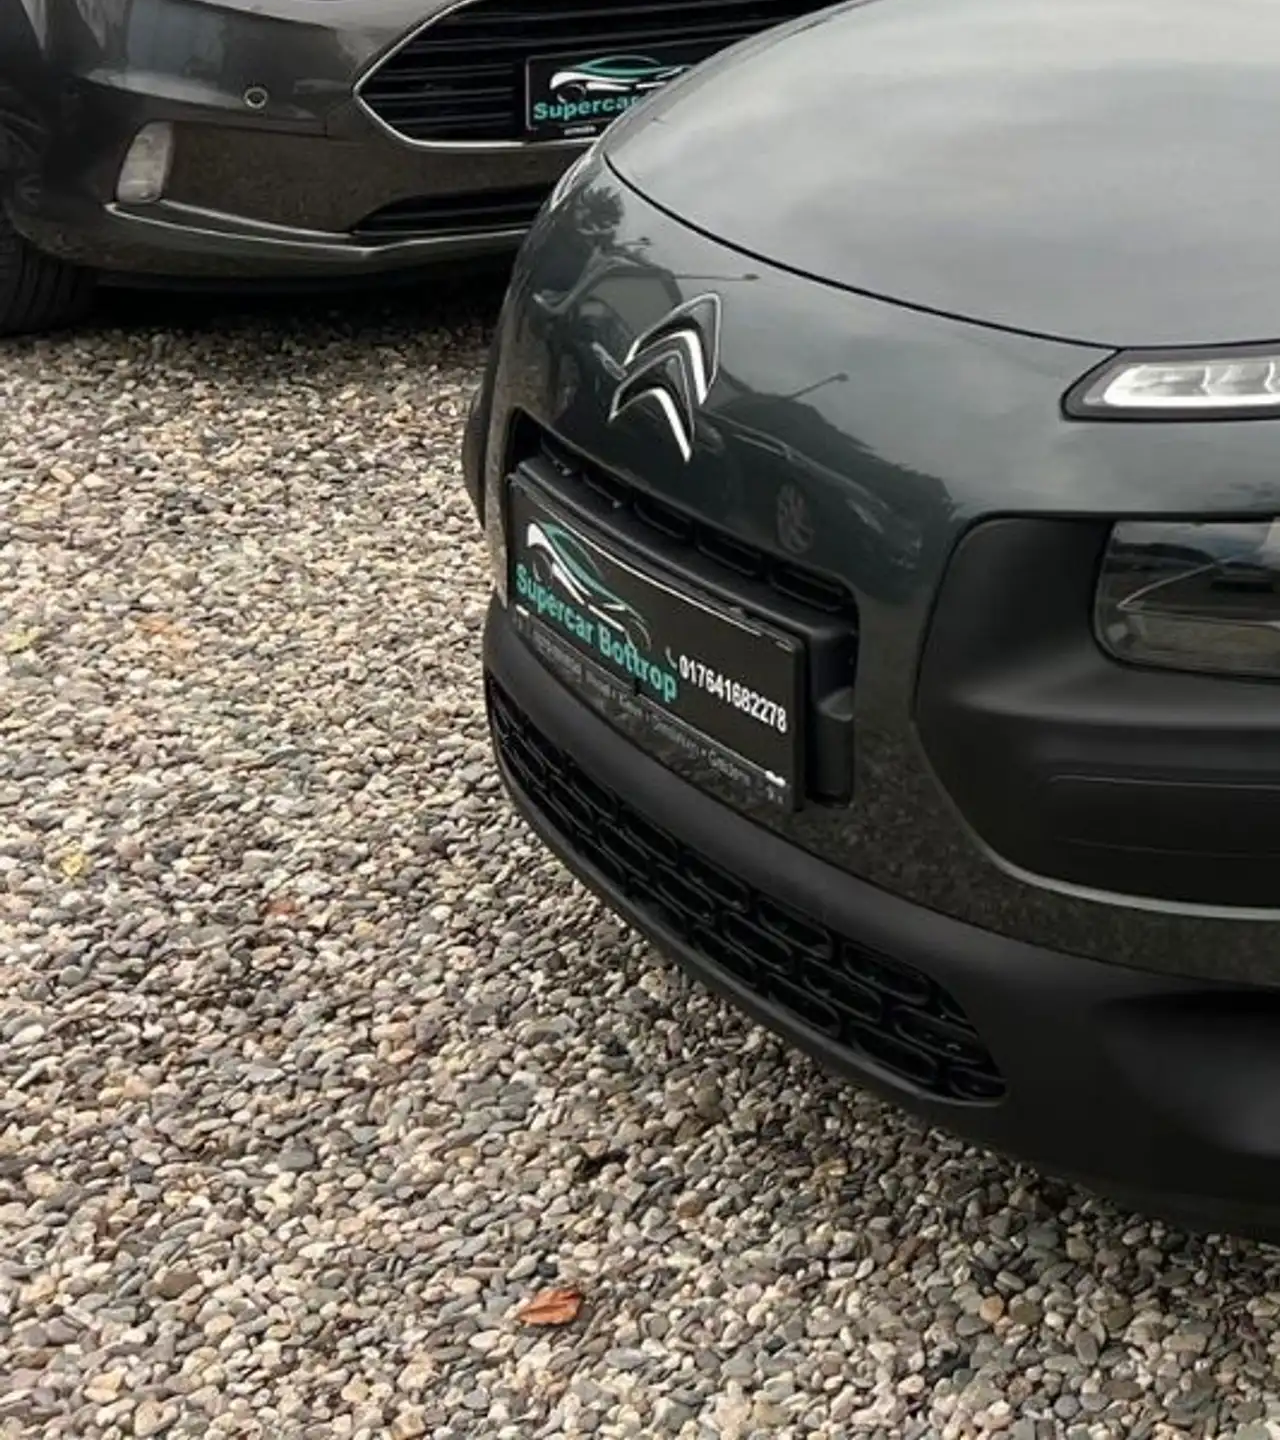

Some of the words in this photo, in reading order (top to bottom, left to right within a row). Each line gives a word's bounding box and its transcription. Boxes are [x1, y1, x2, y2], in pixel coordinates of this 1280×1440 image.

[534, 95, 641, 121] Supercar
[516, 563, 595, 645] Supercar
[598, 623, 677, 703] Bottrop
[679, 654, 787, 734] 017641682278
